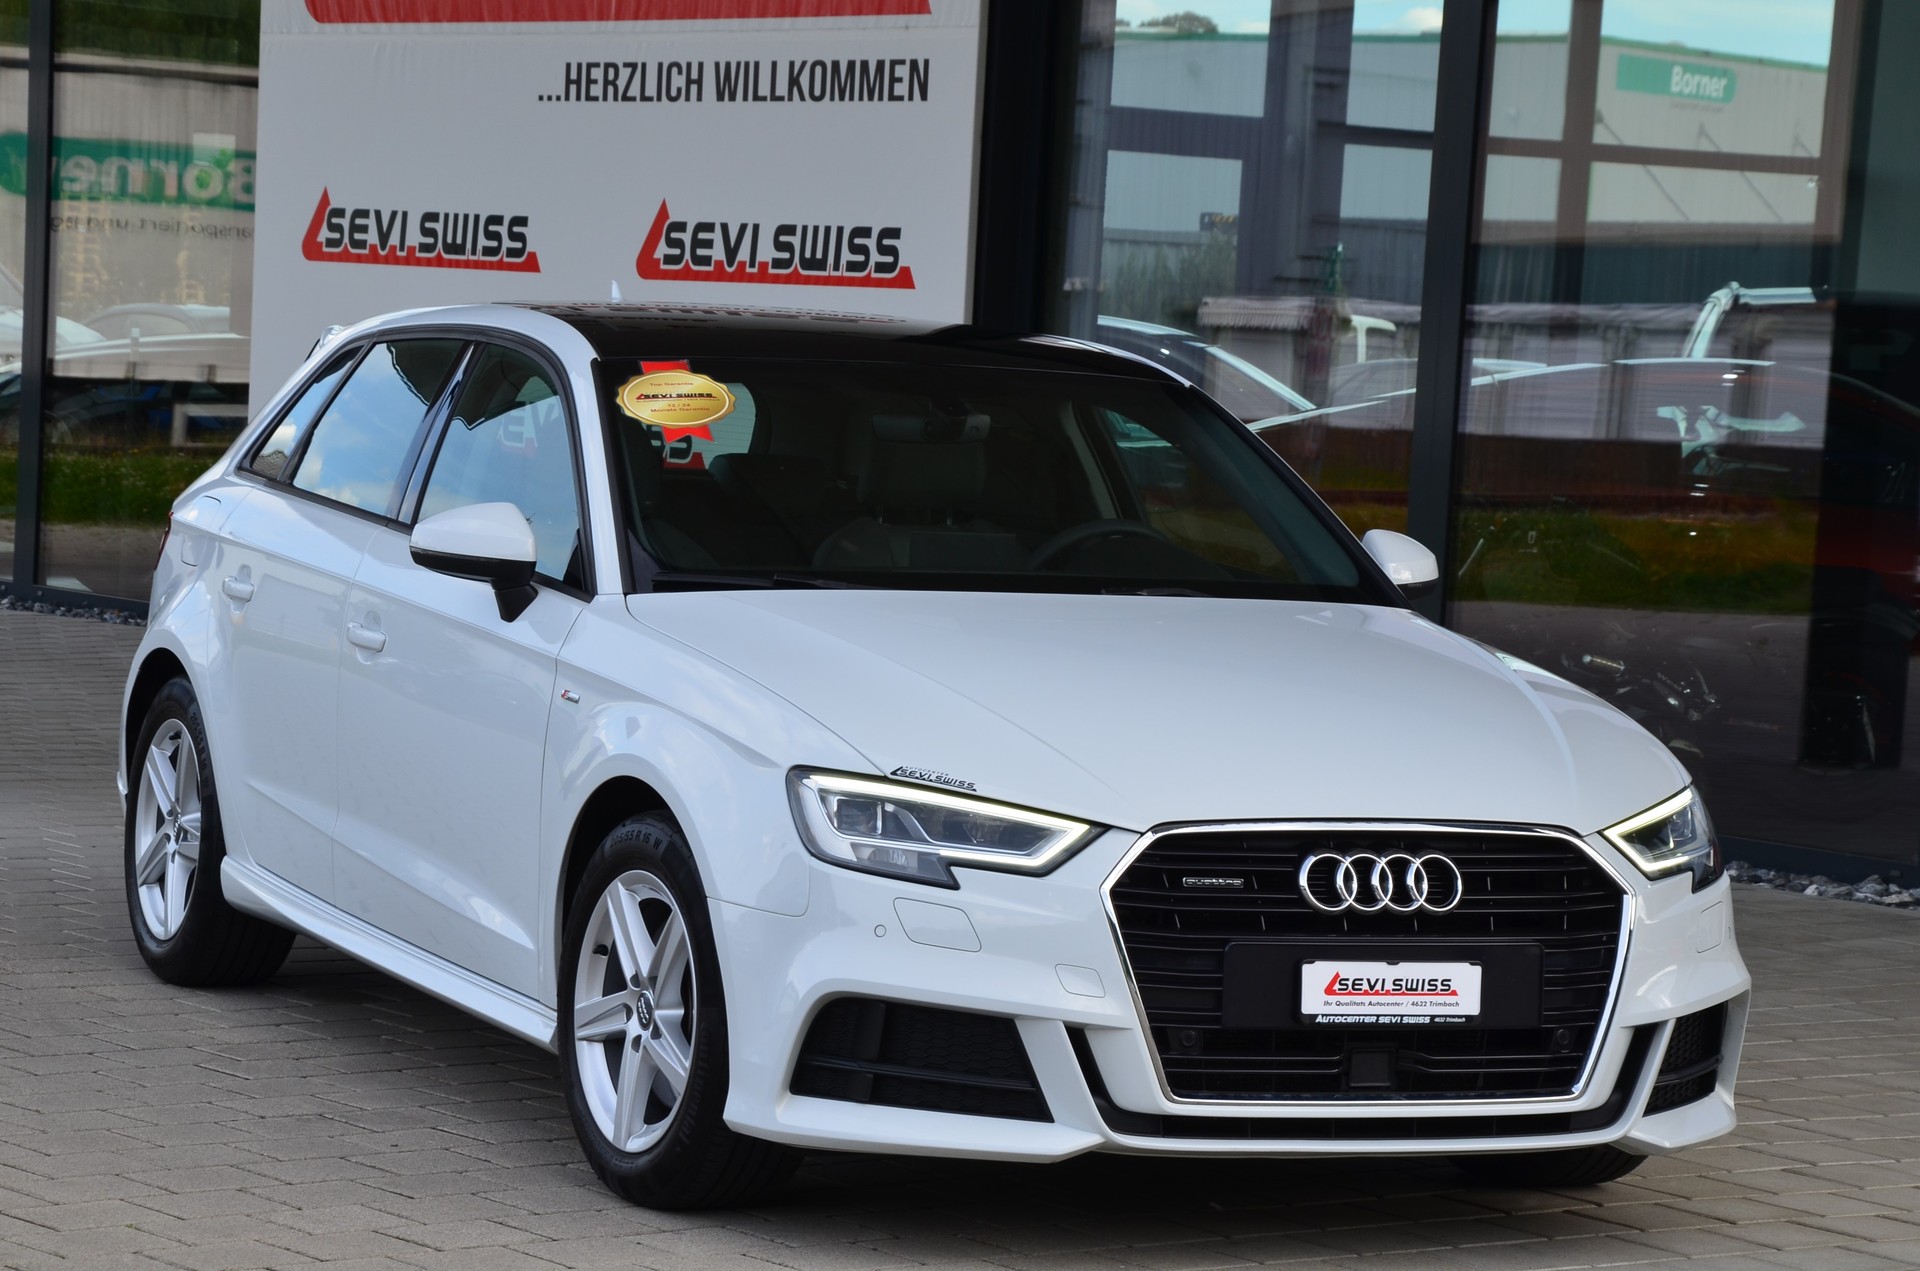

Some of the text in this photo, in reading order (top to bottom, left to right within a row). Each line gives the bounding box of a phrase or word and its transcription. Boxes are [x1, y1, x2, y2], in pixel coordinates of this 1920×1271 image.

[538, 58, 930, 103] ...HERZLICH WILLKOMMEN
[1670, 65, 1728, 98] Borner
[324, 207, 529, 260] SEVI SWISS
[661, 220, 902, 274] SEVI SWISS
[899, 769, 976, 788] SEVI SWISS
[1337, 977, 1452, 993] SEVI SWISS
[1402, 1016, 1431, 1024] SWISS
